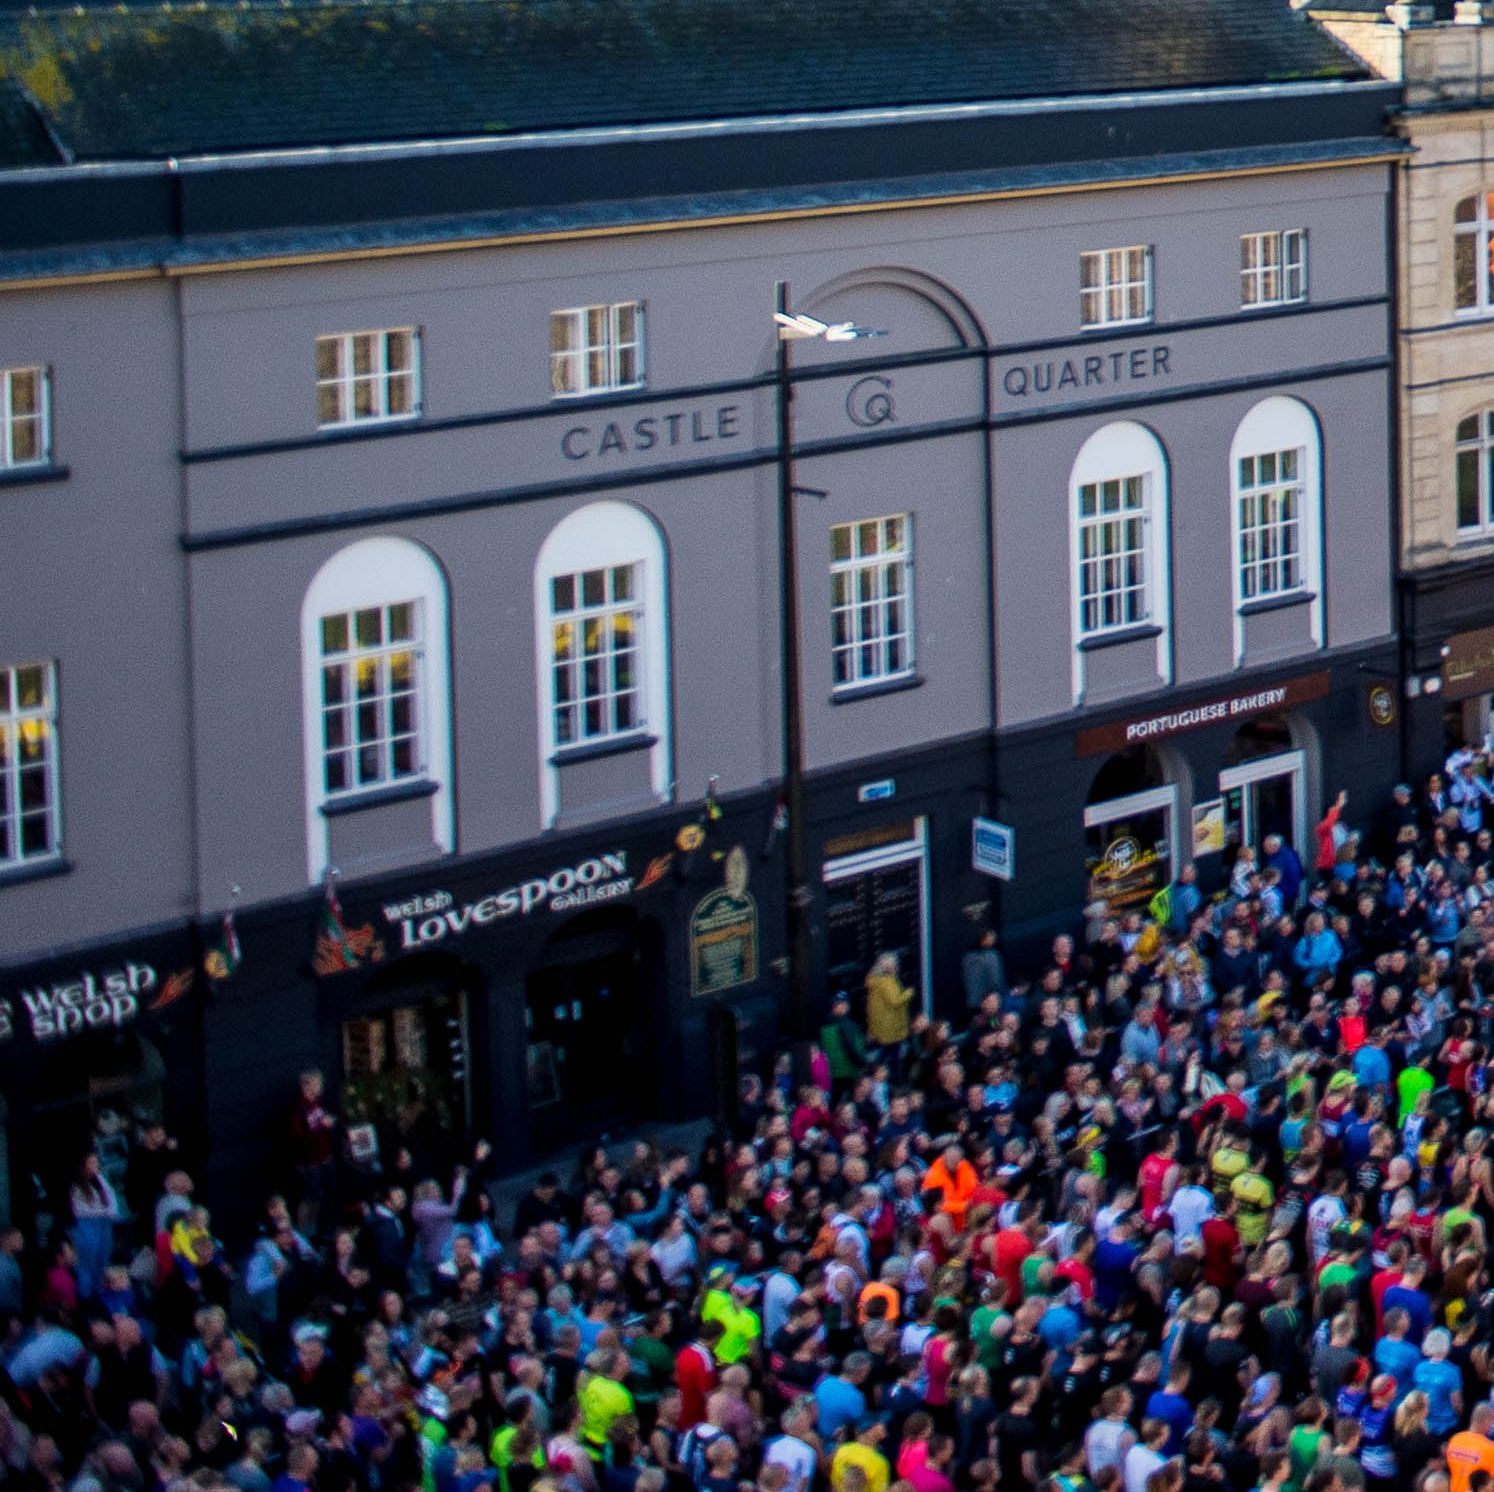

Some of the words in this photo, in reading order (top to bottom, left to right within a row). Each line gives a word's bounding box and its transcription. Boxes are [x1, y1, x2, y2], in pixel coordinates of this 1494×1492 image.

[561, 405, 741, 462] CASTLE
[1004, 345, 1172, 398] QUARTER
[1127, 700, 1229, 741] PORTUGUESE
[1230, 687, 1287, 714] BAKERY
[402, 851, 627, 948] LOVESPOON
